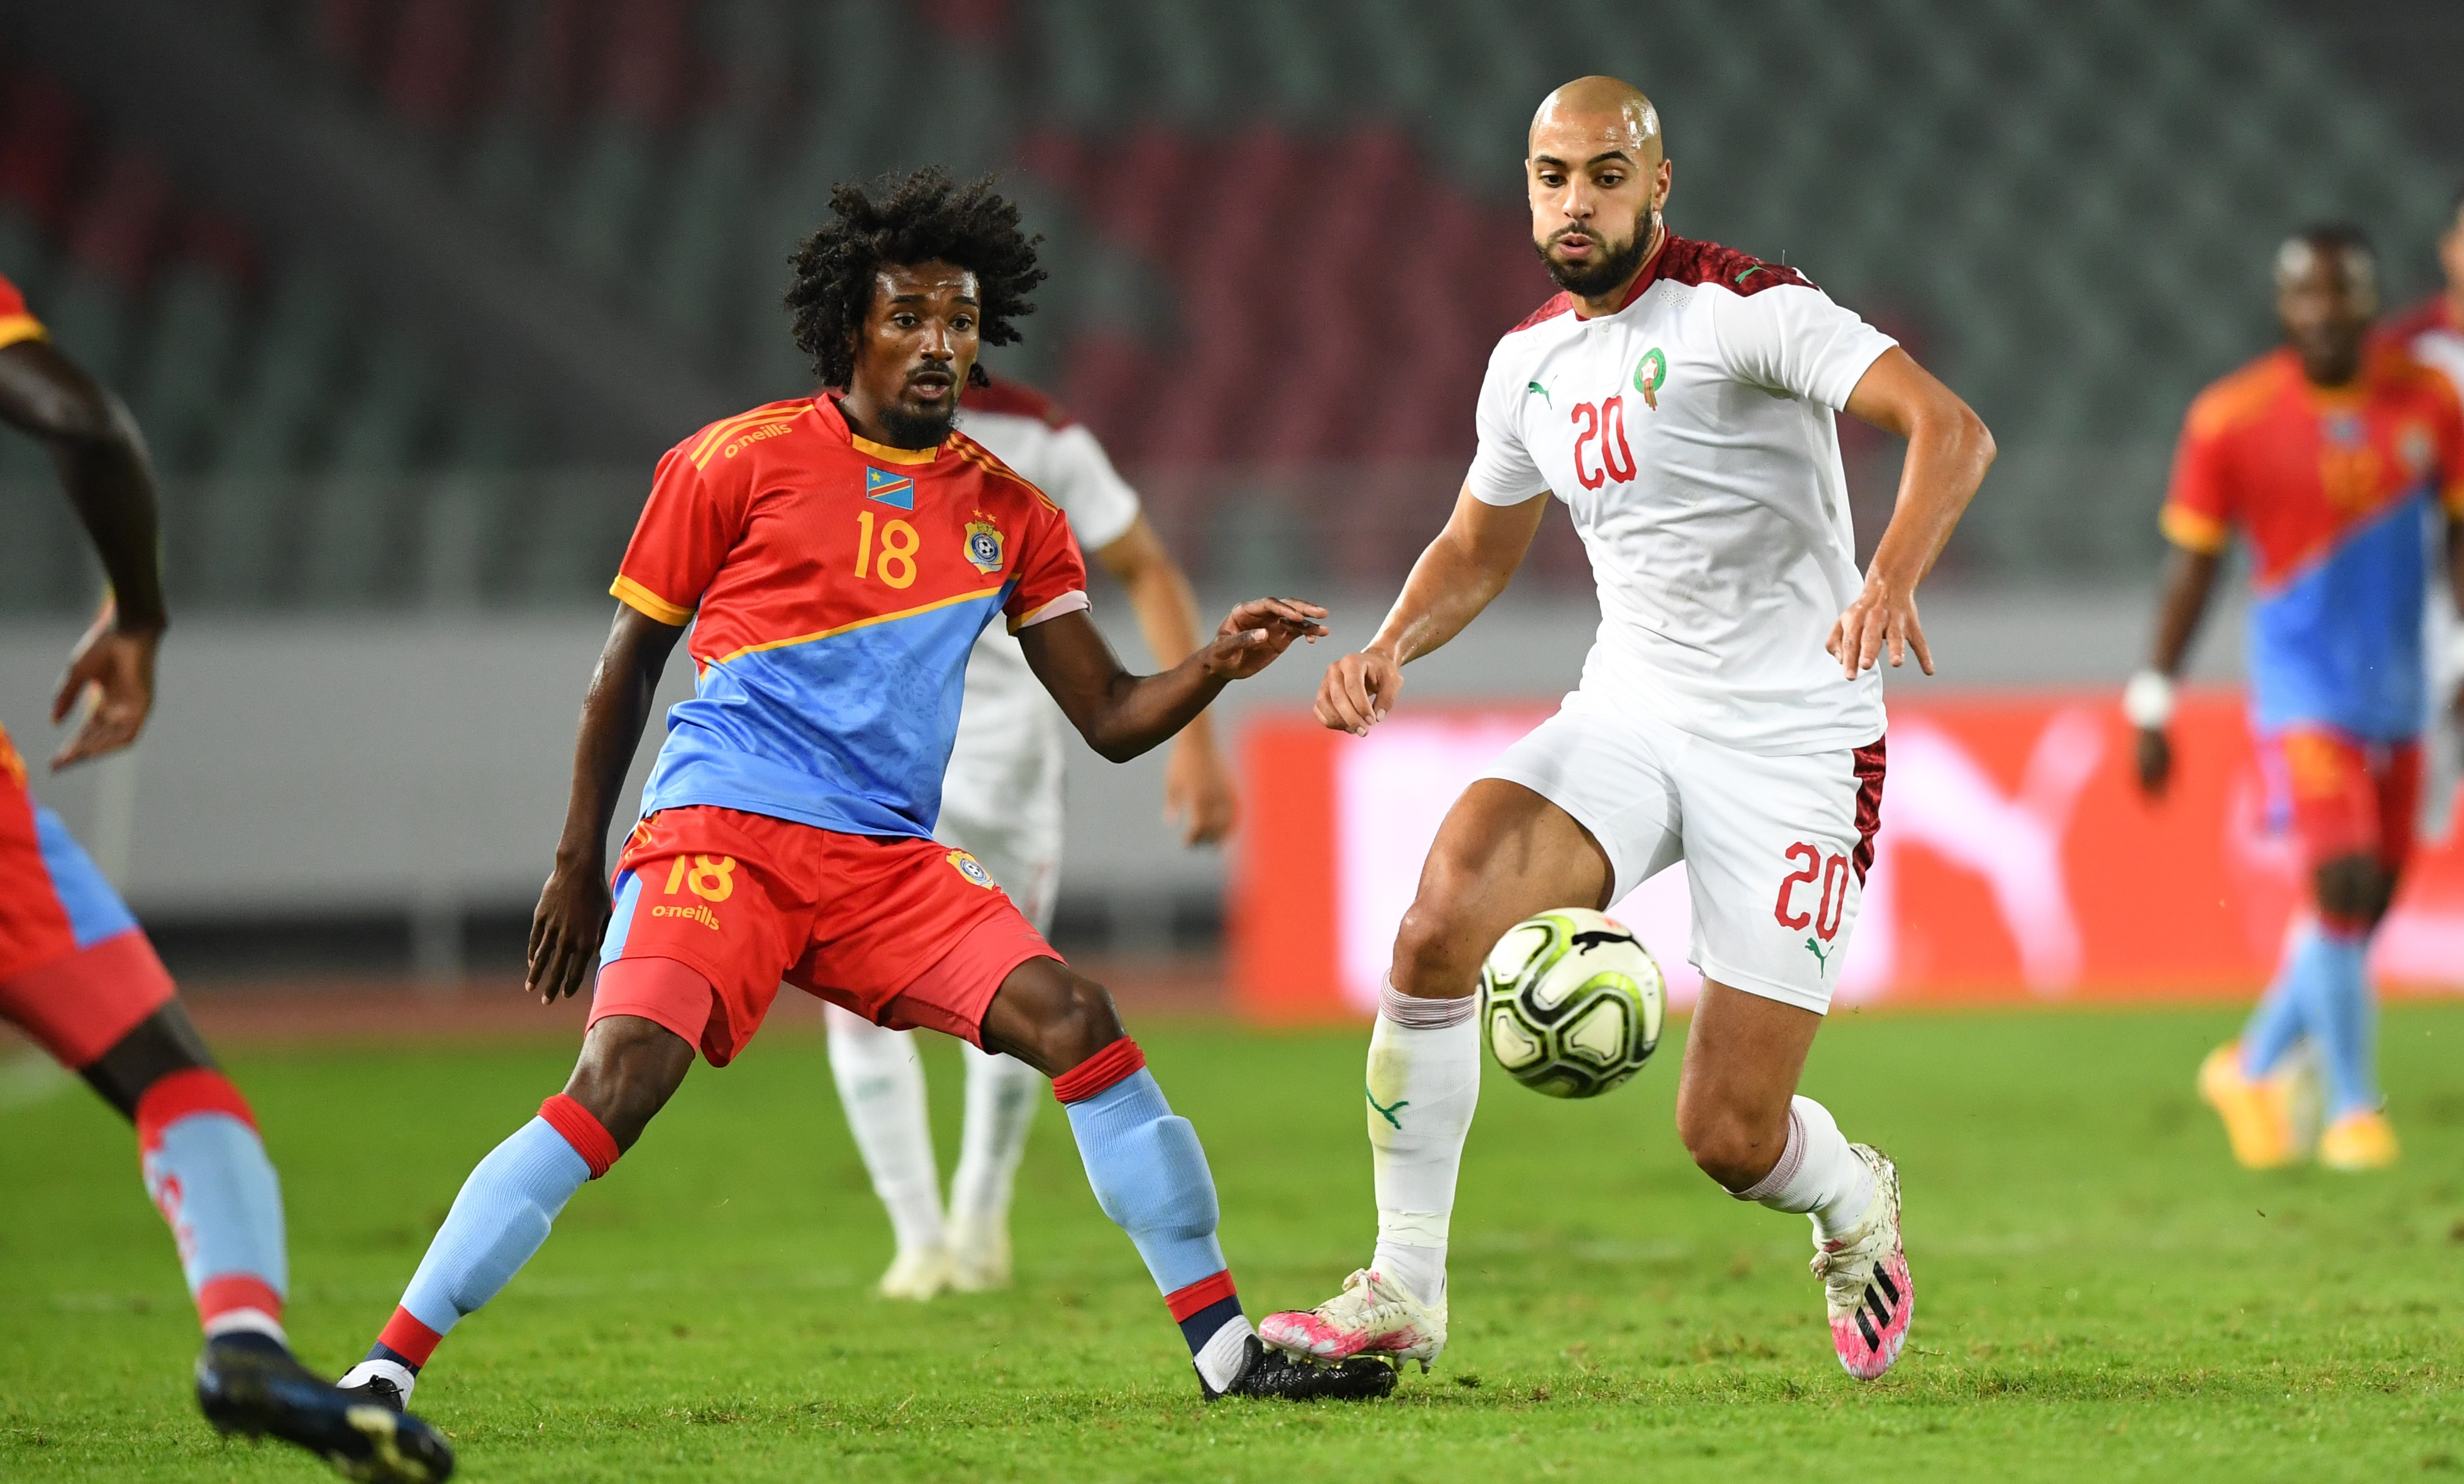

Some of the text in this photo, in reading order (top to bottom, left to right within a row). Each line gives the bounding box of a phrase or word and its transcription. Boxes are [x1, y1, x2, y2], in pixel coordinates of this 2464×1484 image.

[1571, 395, 1637, 491] 20
[854, 510, 920, 589] 18
[663, 854, 736, 902] 18
[1774, 841, 1849, 942] 20
